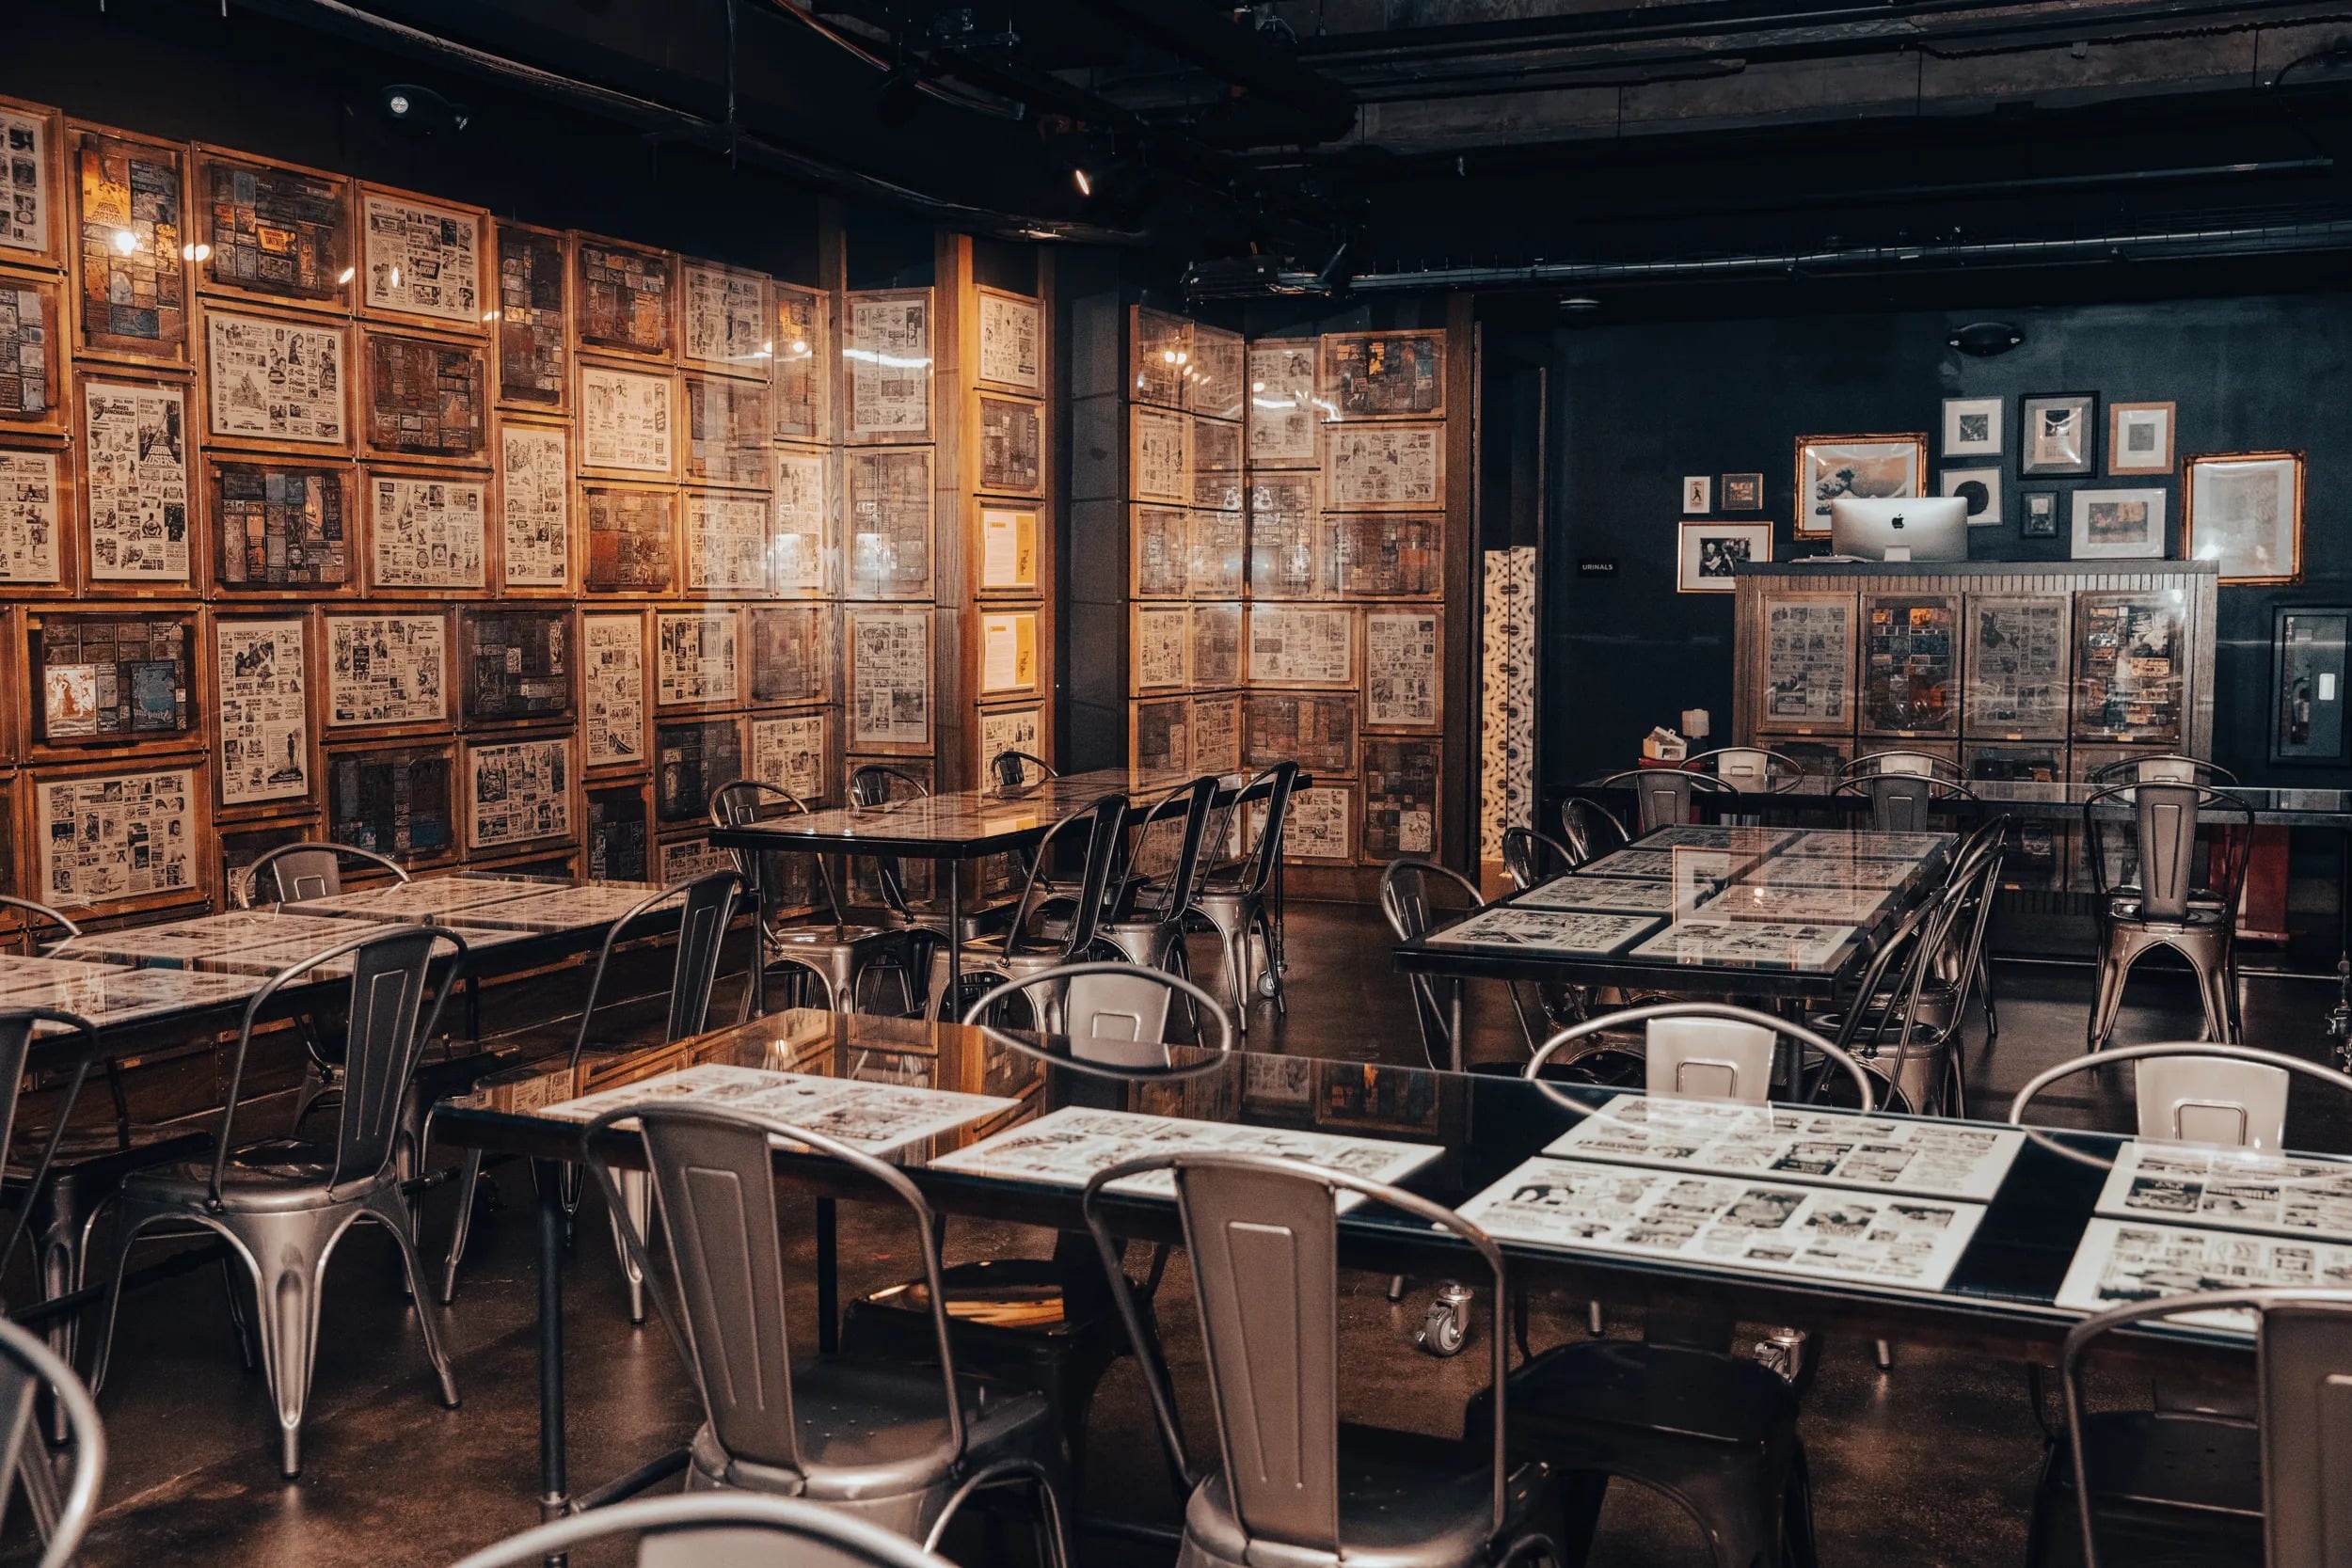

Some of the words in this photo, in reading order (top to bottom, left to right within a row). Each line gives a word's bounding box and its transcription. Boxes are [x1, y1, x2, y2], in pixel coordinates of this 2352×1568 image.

[908, 323, 917, 347] RPM
[149, 445, 172, 455] BORN
[143, 453, 177, 467] LOSERS
